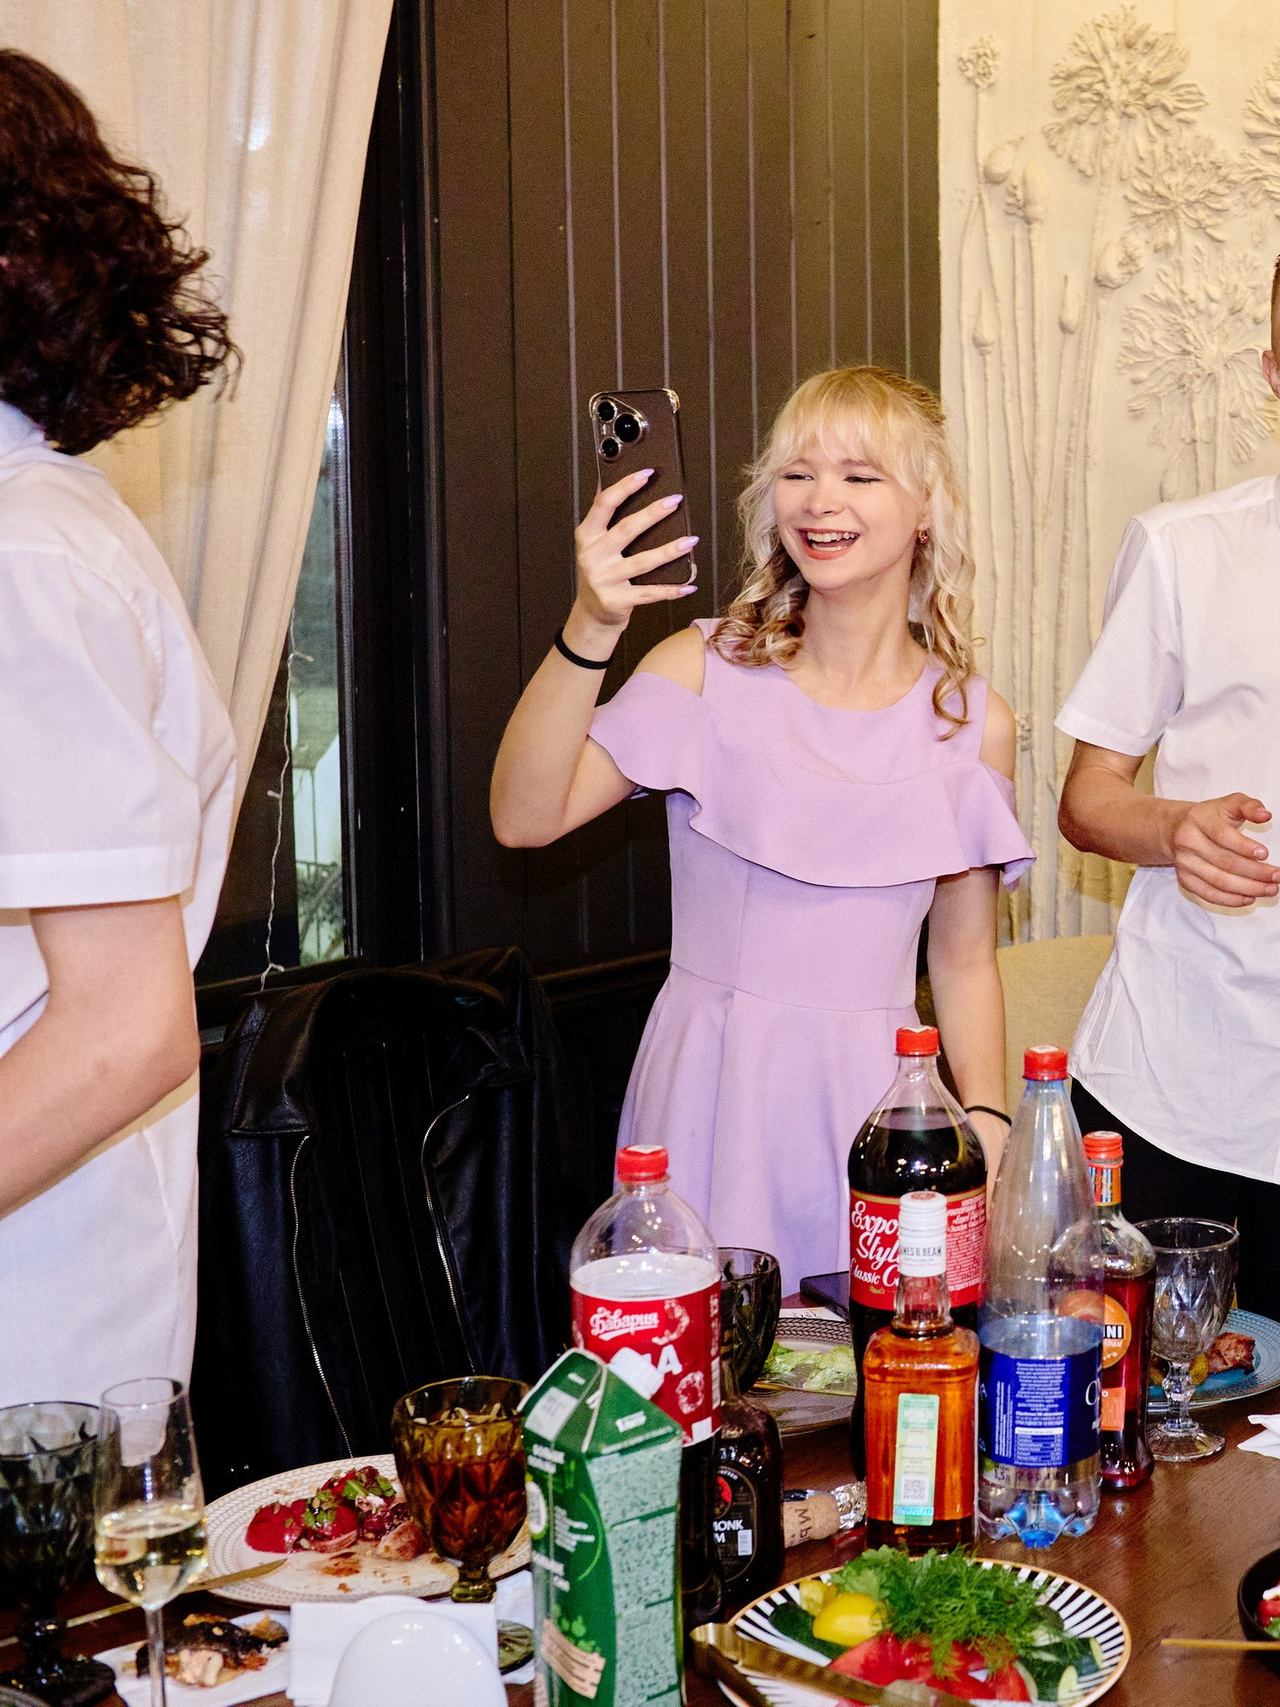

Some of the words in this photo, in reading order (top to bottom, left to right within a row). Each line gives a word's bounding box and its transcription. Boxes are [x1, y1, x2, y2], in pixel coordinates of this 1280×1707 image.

[852, 1201, 900, 1246] Expo
[857, 1231, 900, 1270] Styl
[1103, 1325, 1123, 1339] NI
